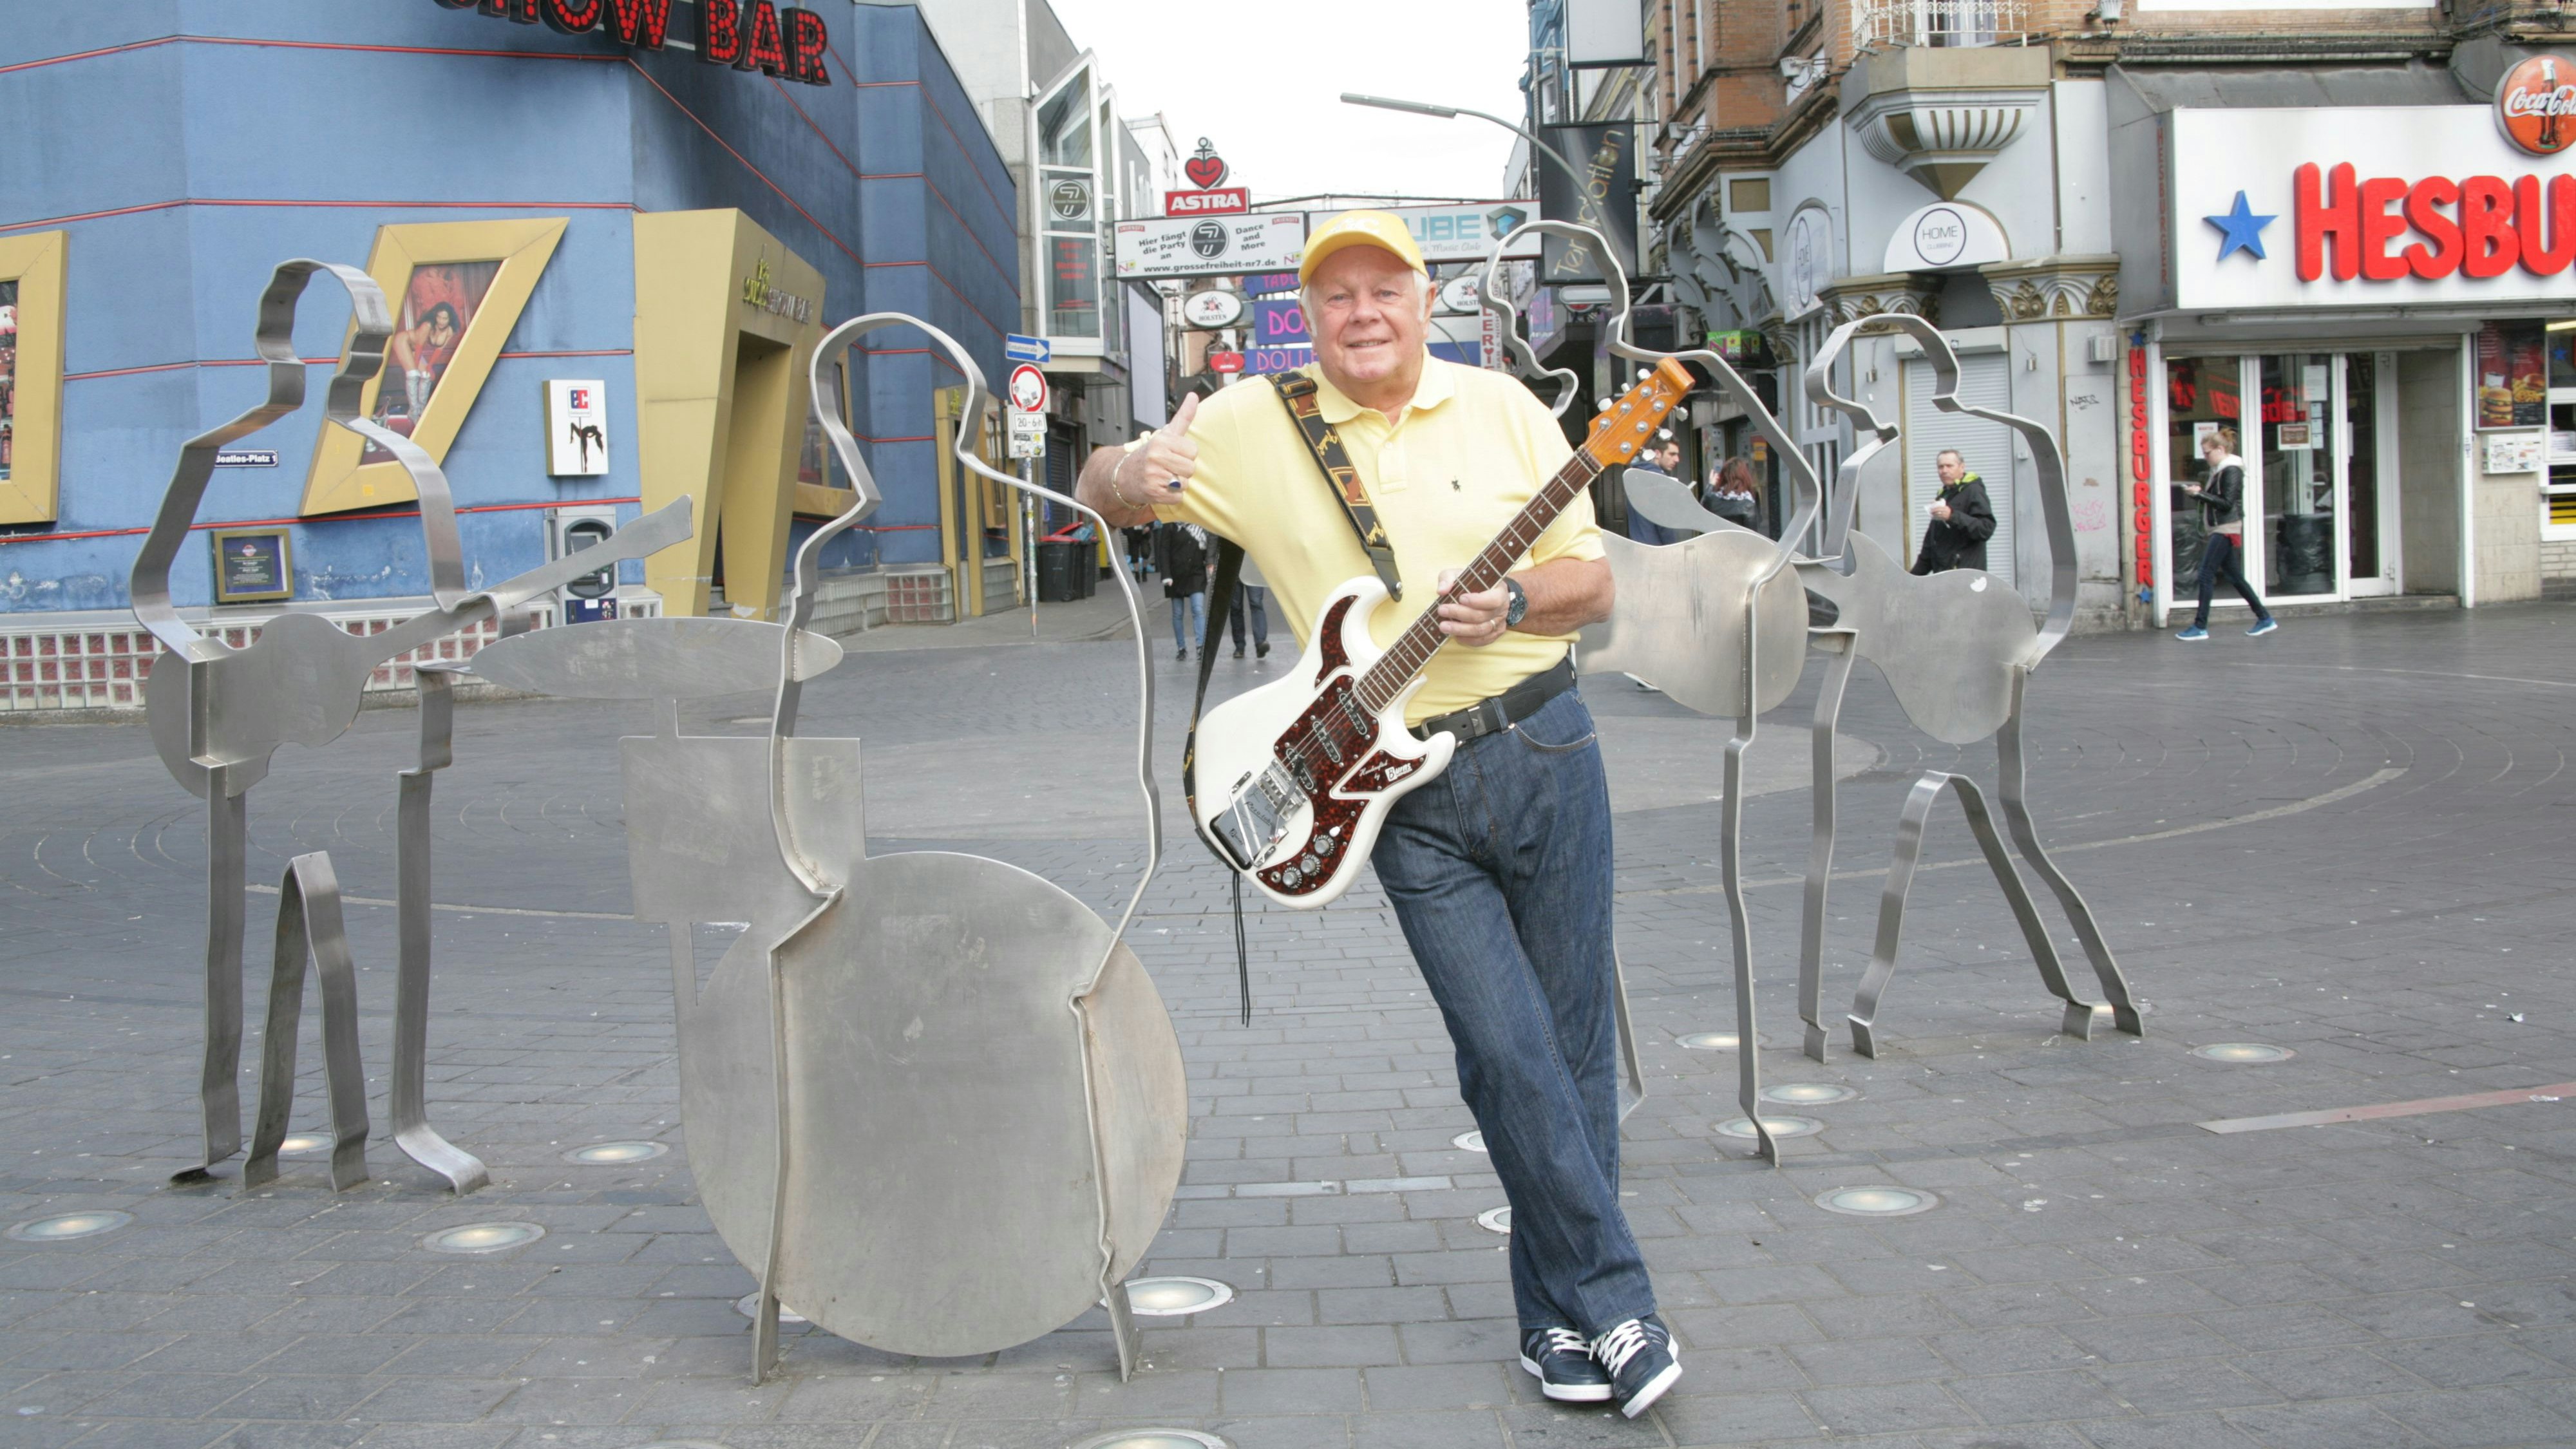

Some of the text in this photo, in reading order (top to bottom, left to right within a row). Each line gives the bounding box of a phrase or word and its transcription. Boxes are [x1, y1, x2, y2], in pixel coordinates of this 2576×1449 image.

[698, 0, 831, 86] BAR
[2504, 84, 2576, 117] Coca-Col
[1171, 193, 1242, 211] ASTRA
[1235, 224, 1264, 234] Dance
[1404, 214, 1481, 242] UBE
[2293, 161, 2576, 283] HESBU
[1139, 238, 1158, 247] Hier
[1161, 231, 1186, 243] fängt
[1243, 233, 1260, 242] and
[1922, 225, 1958, 240] HOME
[1160, 240, 1186, 251] Party
[1241, 241, 1265, 251] More
[1432, 243, 1459, 252] Music
[1461, 242, 1481, 251] Club
[1144, 259, 1276, 273] www.grossefreiheit-nr7.de
[1261, 273, 1299, 289] TABL
[1268, 308, 1305, 335] DO
[1018, 417, 1027, 427] 20
[216, 455, 270, 463] Beatles-Platz
[2128, 348, 2154, 587] HESBURGER
[1385, 762, 1412, 782] Burns
